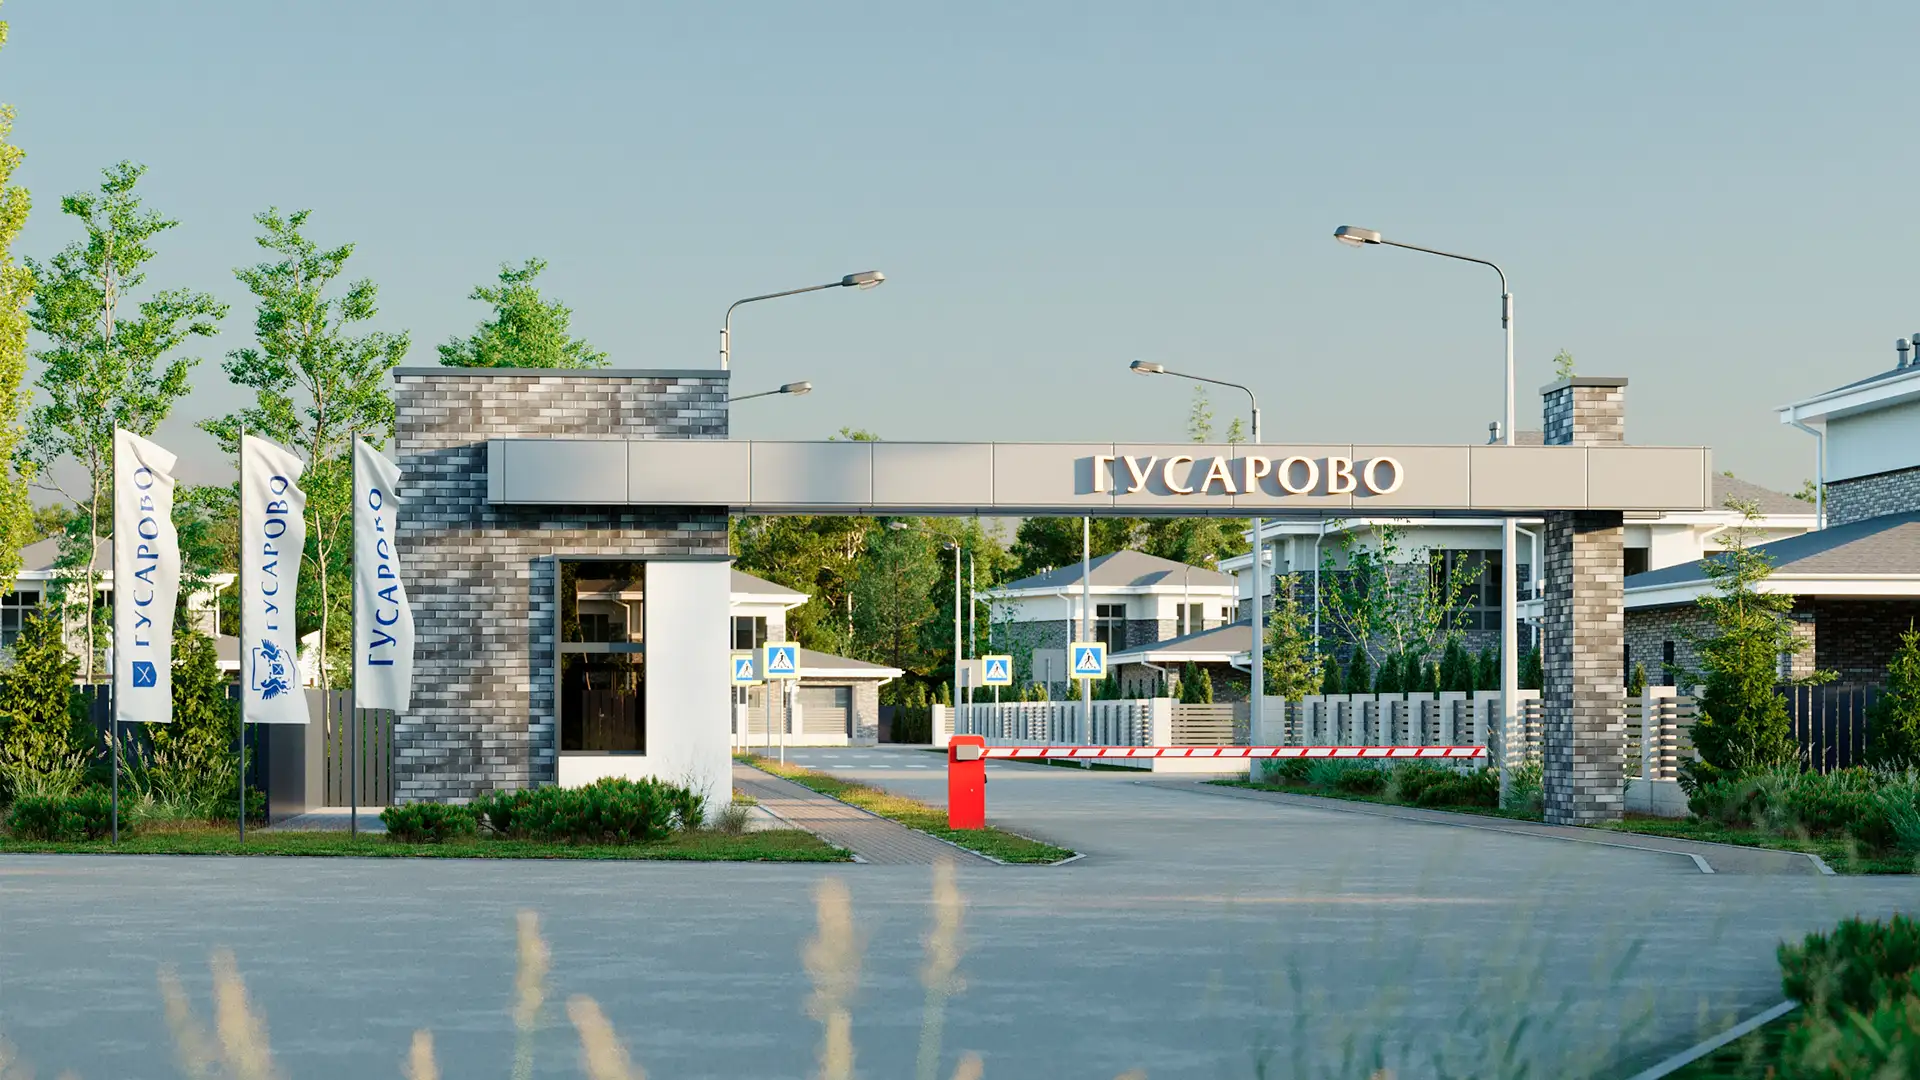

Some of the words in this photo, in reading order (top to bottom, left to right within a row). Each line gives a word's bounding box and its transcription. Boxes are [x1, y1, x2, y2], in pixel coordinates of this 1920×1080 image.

[261, 474, 289, 631] ГУСАРОВО
[1092, 455, 1405, 495] ГУСАРОВО
[133, 465, 159, 647] ГУСАРОВО
